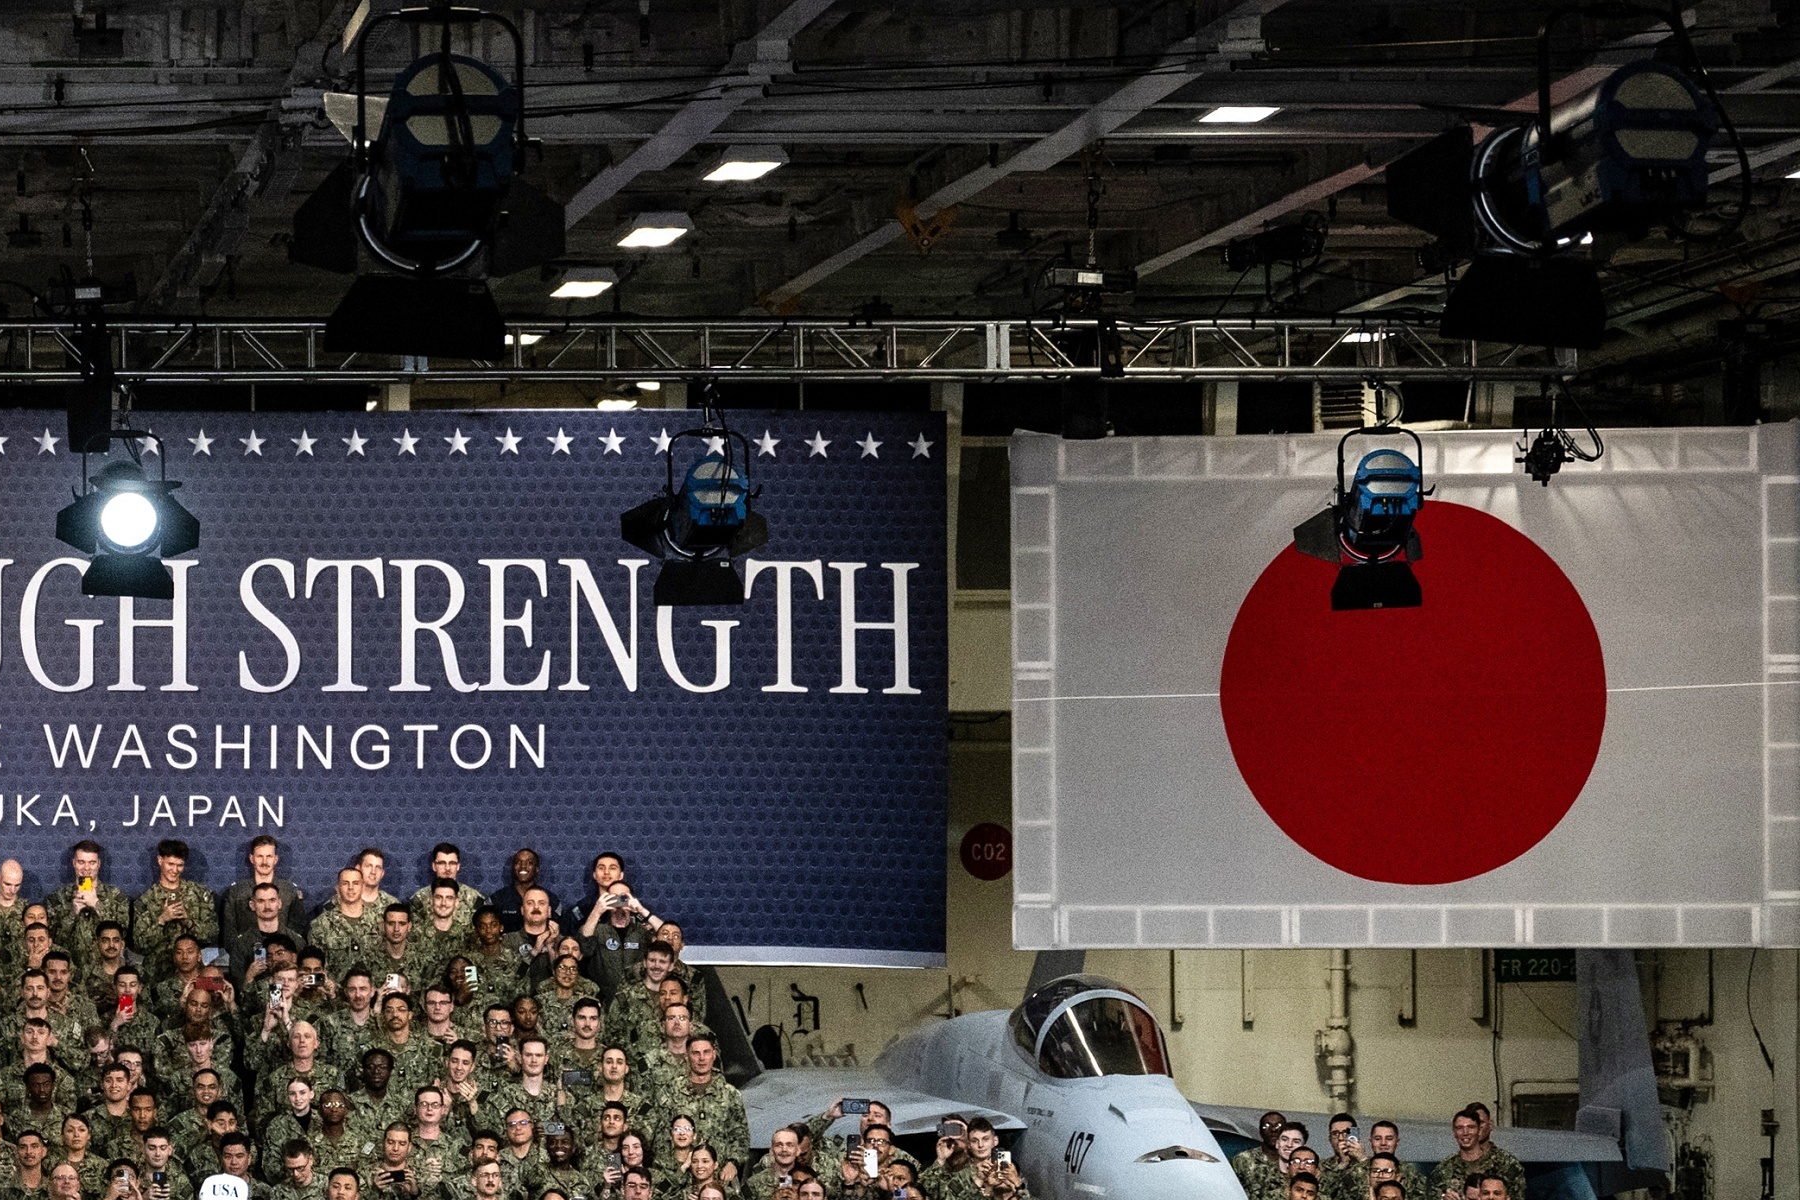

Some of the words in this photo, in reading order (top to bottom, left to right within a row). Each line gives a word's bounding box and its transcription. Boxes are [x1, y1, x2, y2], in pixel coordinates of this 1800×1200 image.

[239, 557, 922, 695] STRENGTH
[43, 723, 545, 770] WASHINGTON
[122, 794, 284, 828] JAPAN
[971, 843, 1006, 861] CO2
[1501, 959, 1521, 977] FR
[1063, 1130, 1095, 1175] 407
[212, 1183, 239, 1198] USA
